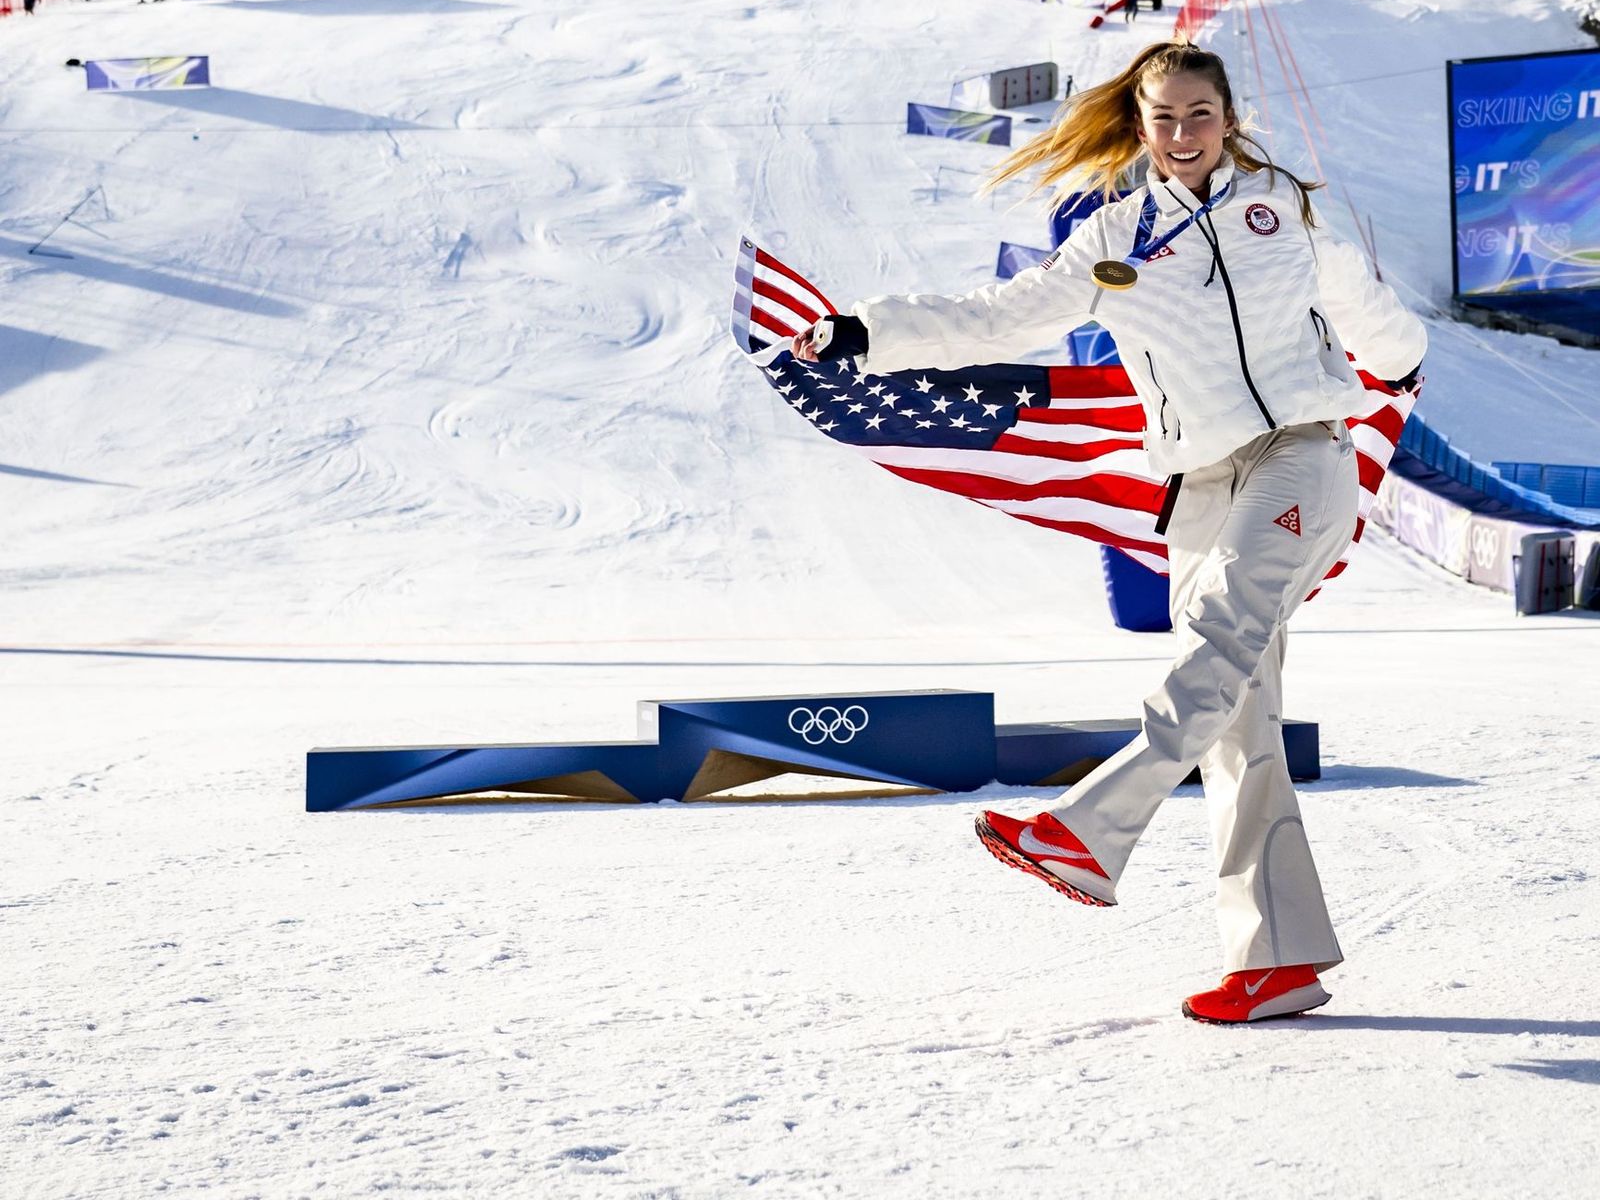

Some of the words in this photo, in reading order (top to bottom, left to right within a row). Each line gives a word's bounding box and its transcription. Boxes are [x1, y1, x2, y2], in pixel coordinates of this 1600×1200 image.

[1457, 92, 1573, 128] SKIING
[1475, 159, 1541, 192] IT'S
[1505, 222, 1571, 256] IT'S
